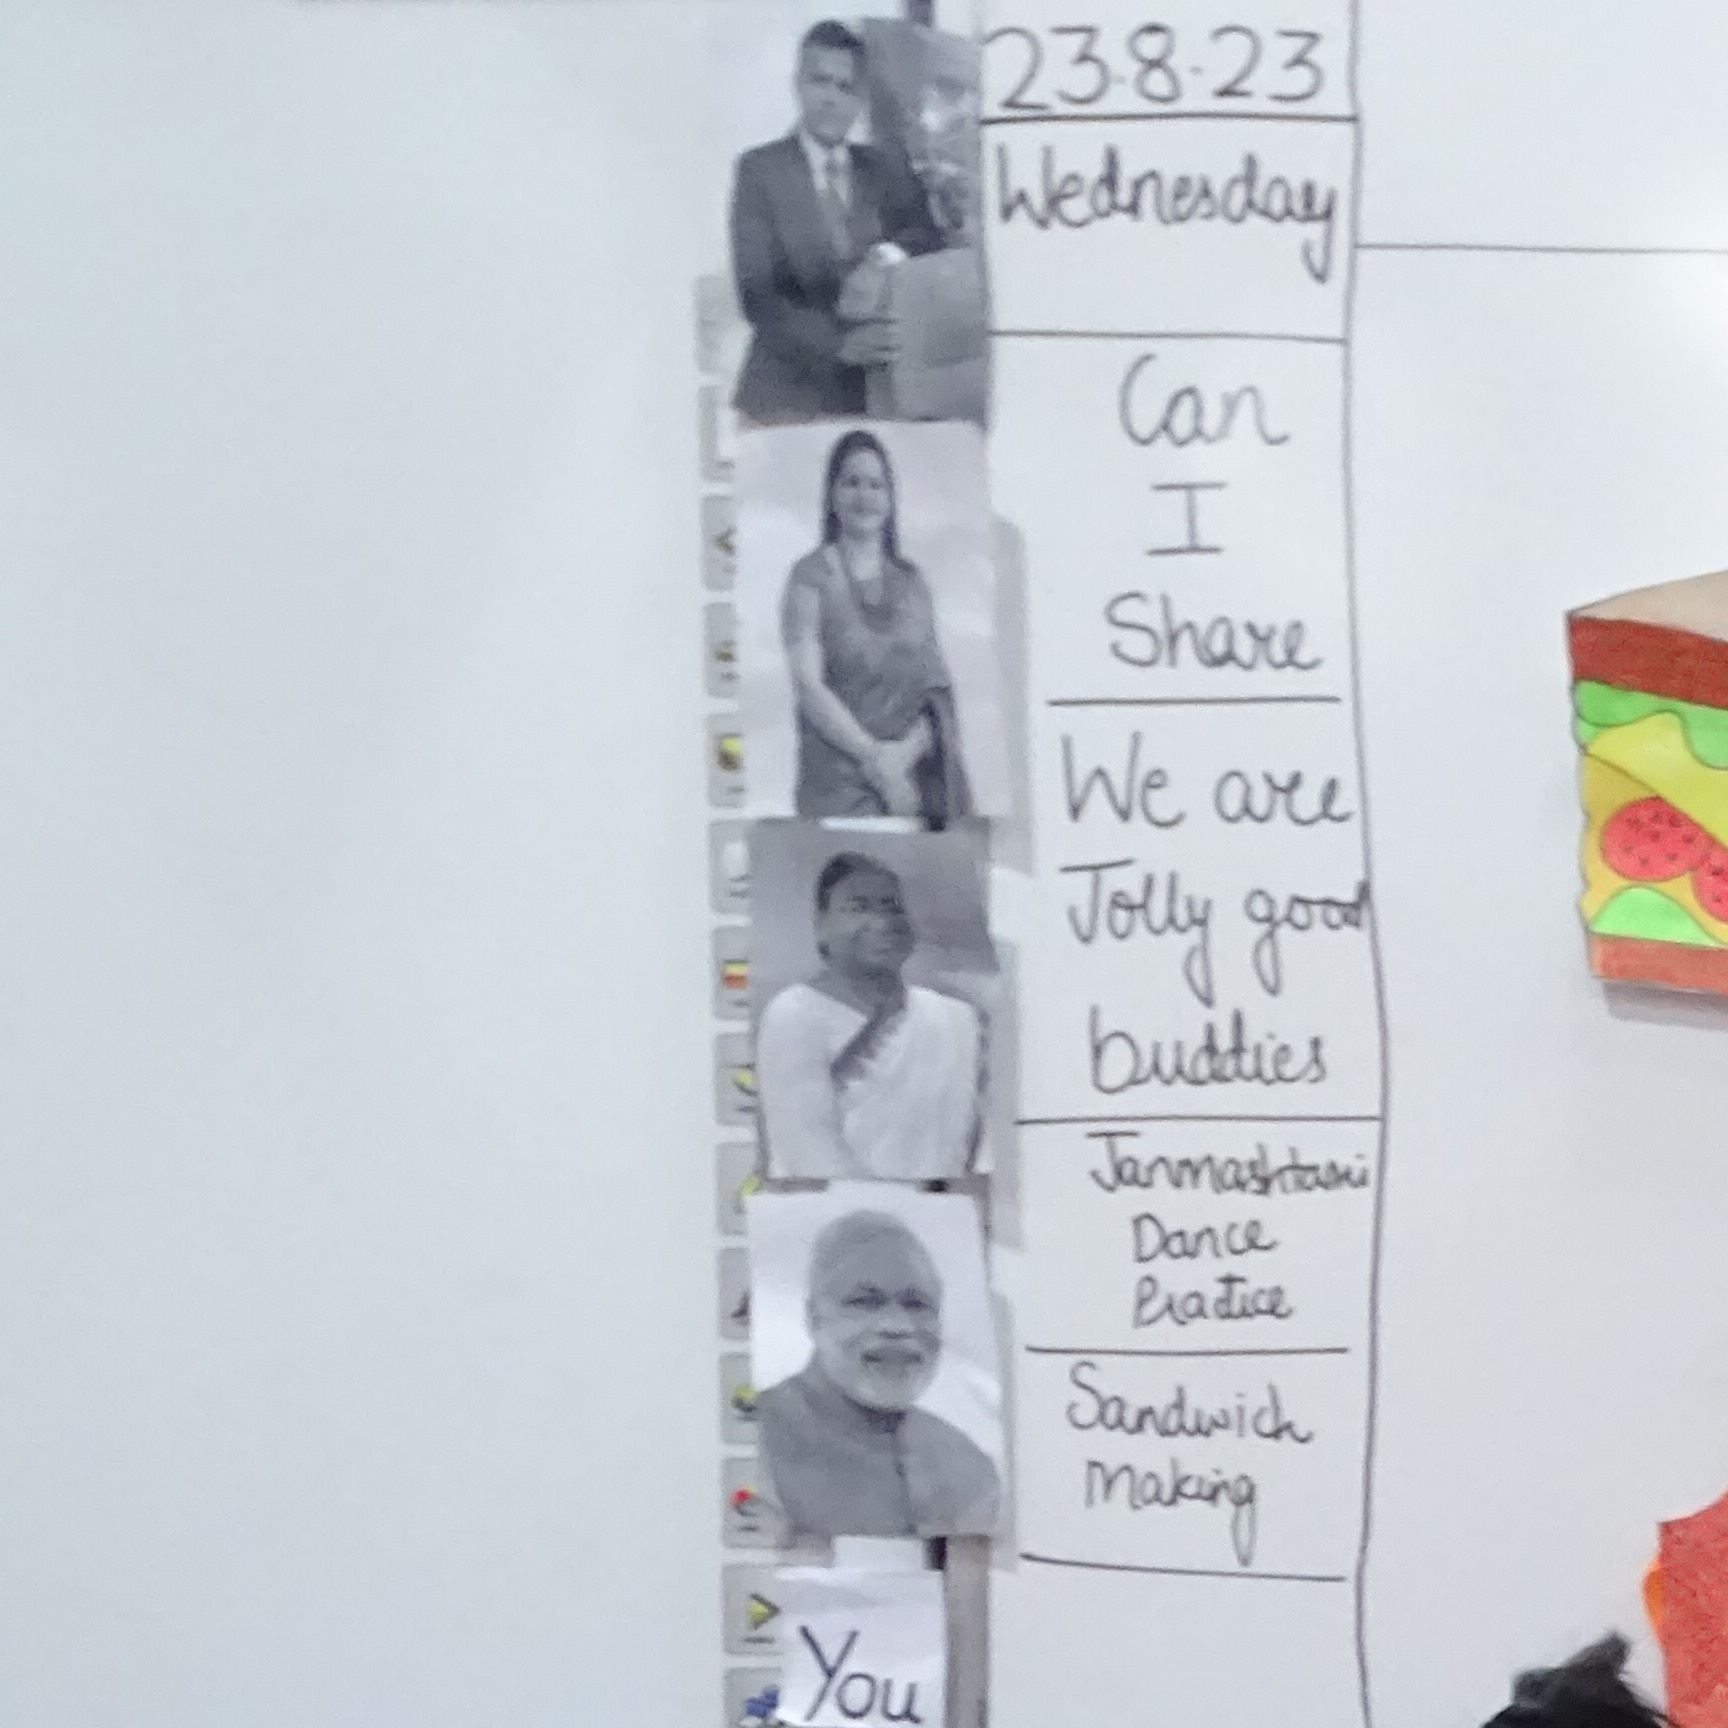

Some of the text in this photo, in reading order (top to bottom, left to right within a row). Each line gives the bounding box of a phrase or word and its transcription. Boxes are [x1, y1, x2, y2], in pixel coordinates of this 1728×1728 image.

[996, 143, 1338, 285] Wednesday
[1118, 353, 1290, 448] Can
[1145, 481, 1228, 557] I
[1102, 590, 1323, 672] Share
[1061, 731, 1356, 830] We are
[1059, 857, 1370, 1010] Jolly good
[1087, 1003, 1328, 1095] buddies
[1132, 1212, 1281, 1264] Dance
[1064, 1360, 1316, 1444] Sandwich
[798, 1623, 924, 1724] You
